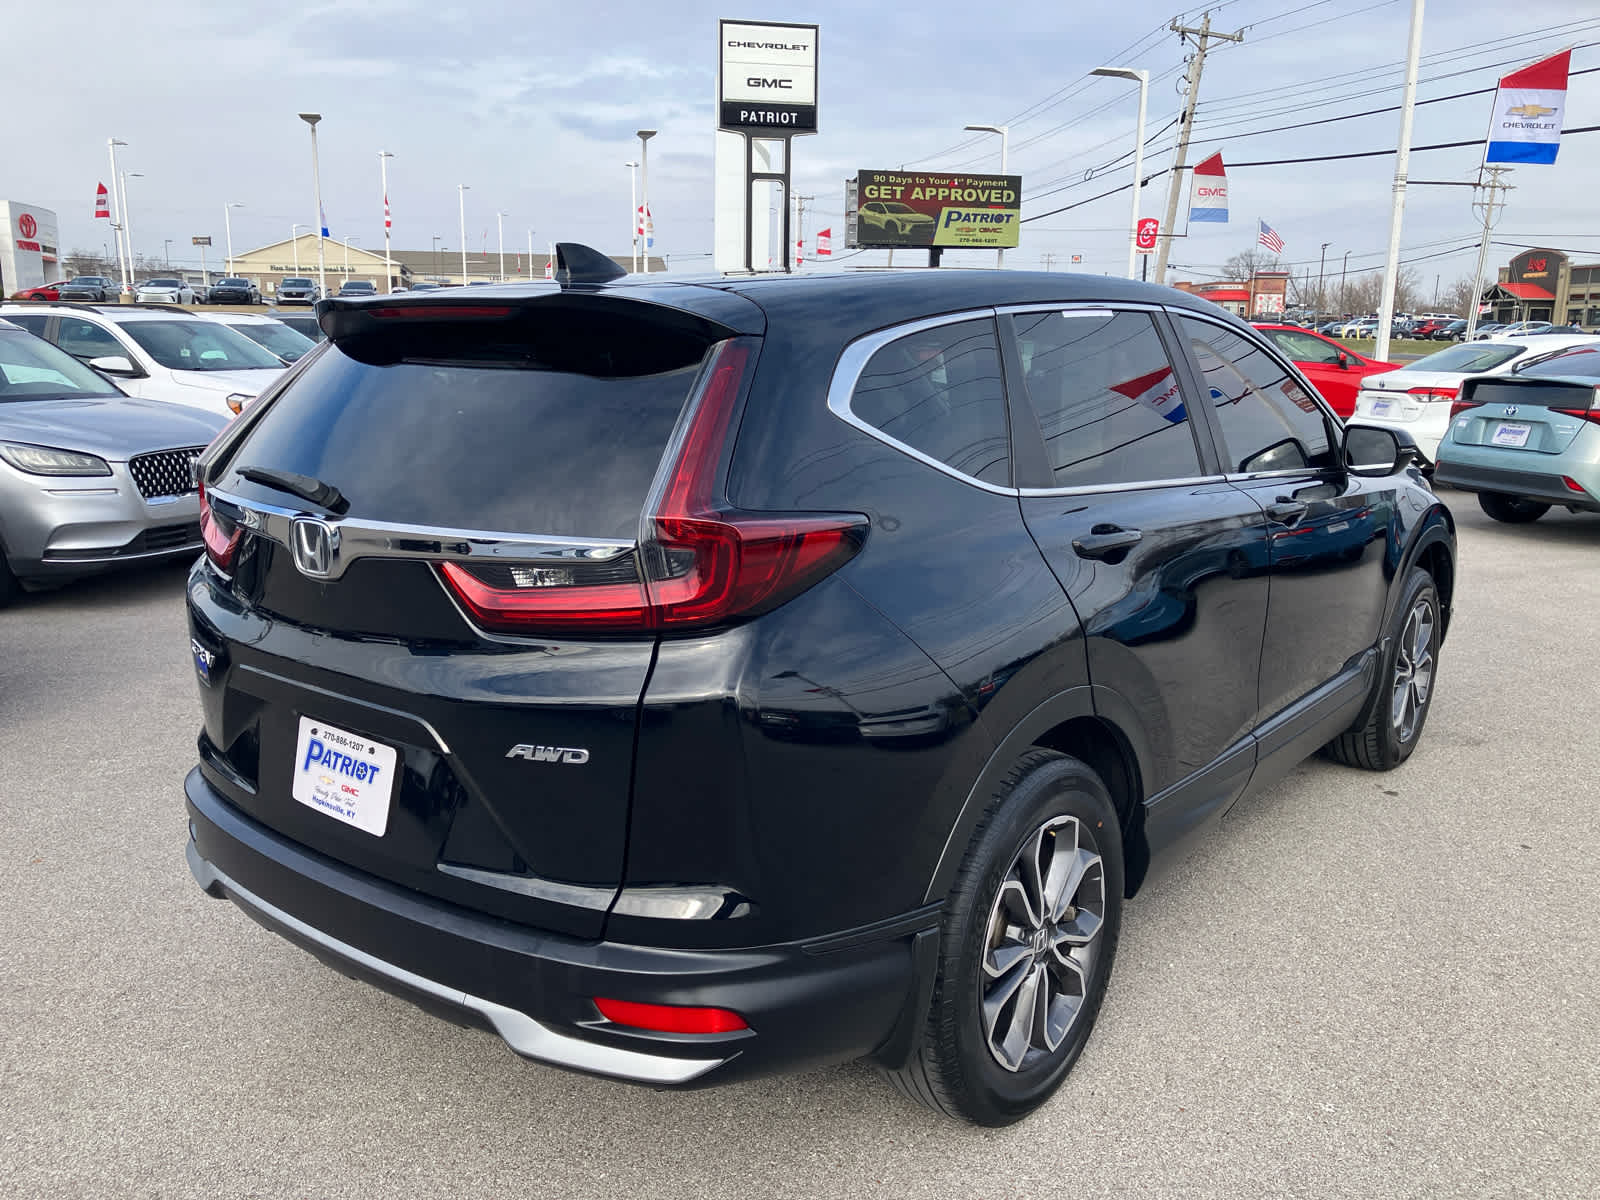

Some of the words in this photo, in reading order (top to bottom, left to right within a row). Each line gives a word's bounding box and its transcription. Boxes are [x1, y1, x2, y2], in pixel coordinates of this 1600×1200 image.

[727, 41, 809, 51] CHEVROLET
[746, 77, 793, 89] GMC
[740, 110, 798, 124] PATRIOT
[873, 175, 886, 183] 90
[889, 175, 912, 184] Days
[929, 177, 950, 185] Your
[966, 178, 1008, 188] Payment
[864, 185, 905, 199] GET
[910, 187, 1016, 203] APPROVED
[1197, 187, 1227, 197] GMC
[944, 210, 1014, 228] PATRIOT
[323, 730, 364, 752] 270-886-1207
[504, 743, 590, 764] AWD
[303, 738, 380, 785] PATRIOT
[341, 784, 360, 797] GMC
[346, 810, 356, 819] KY
